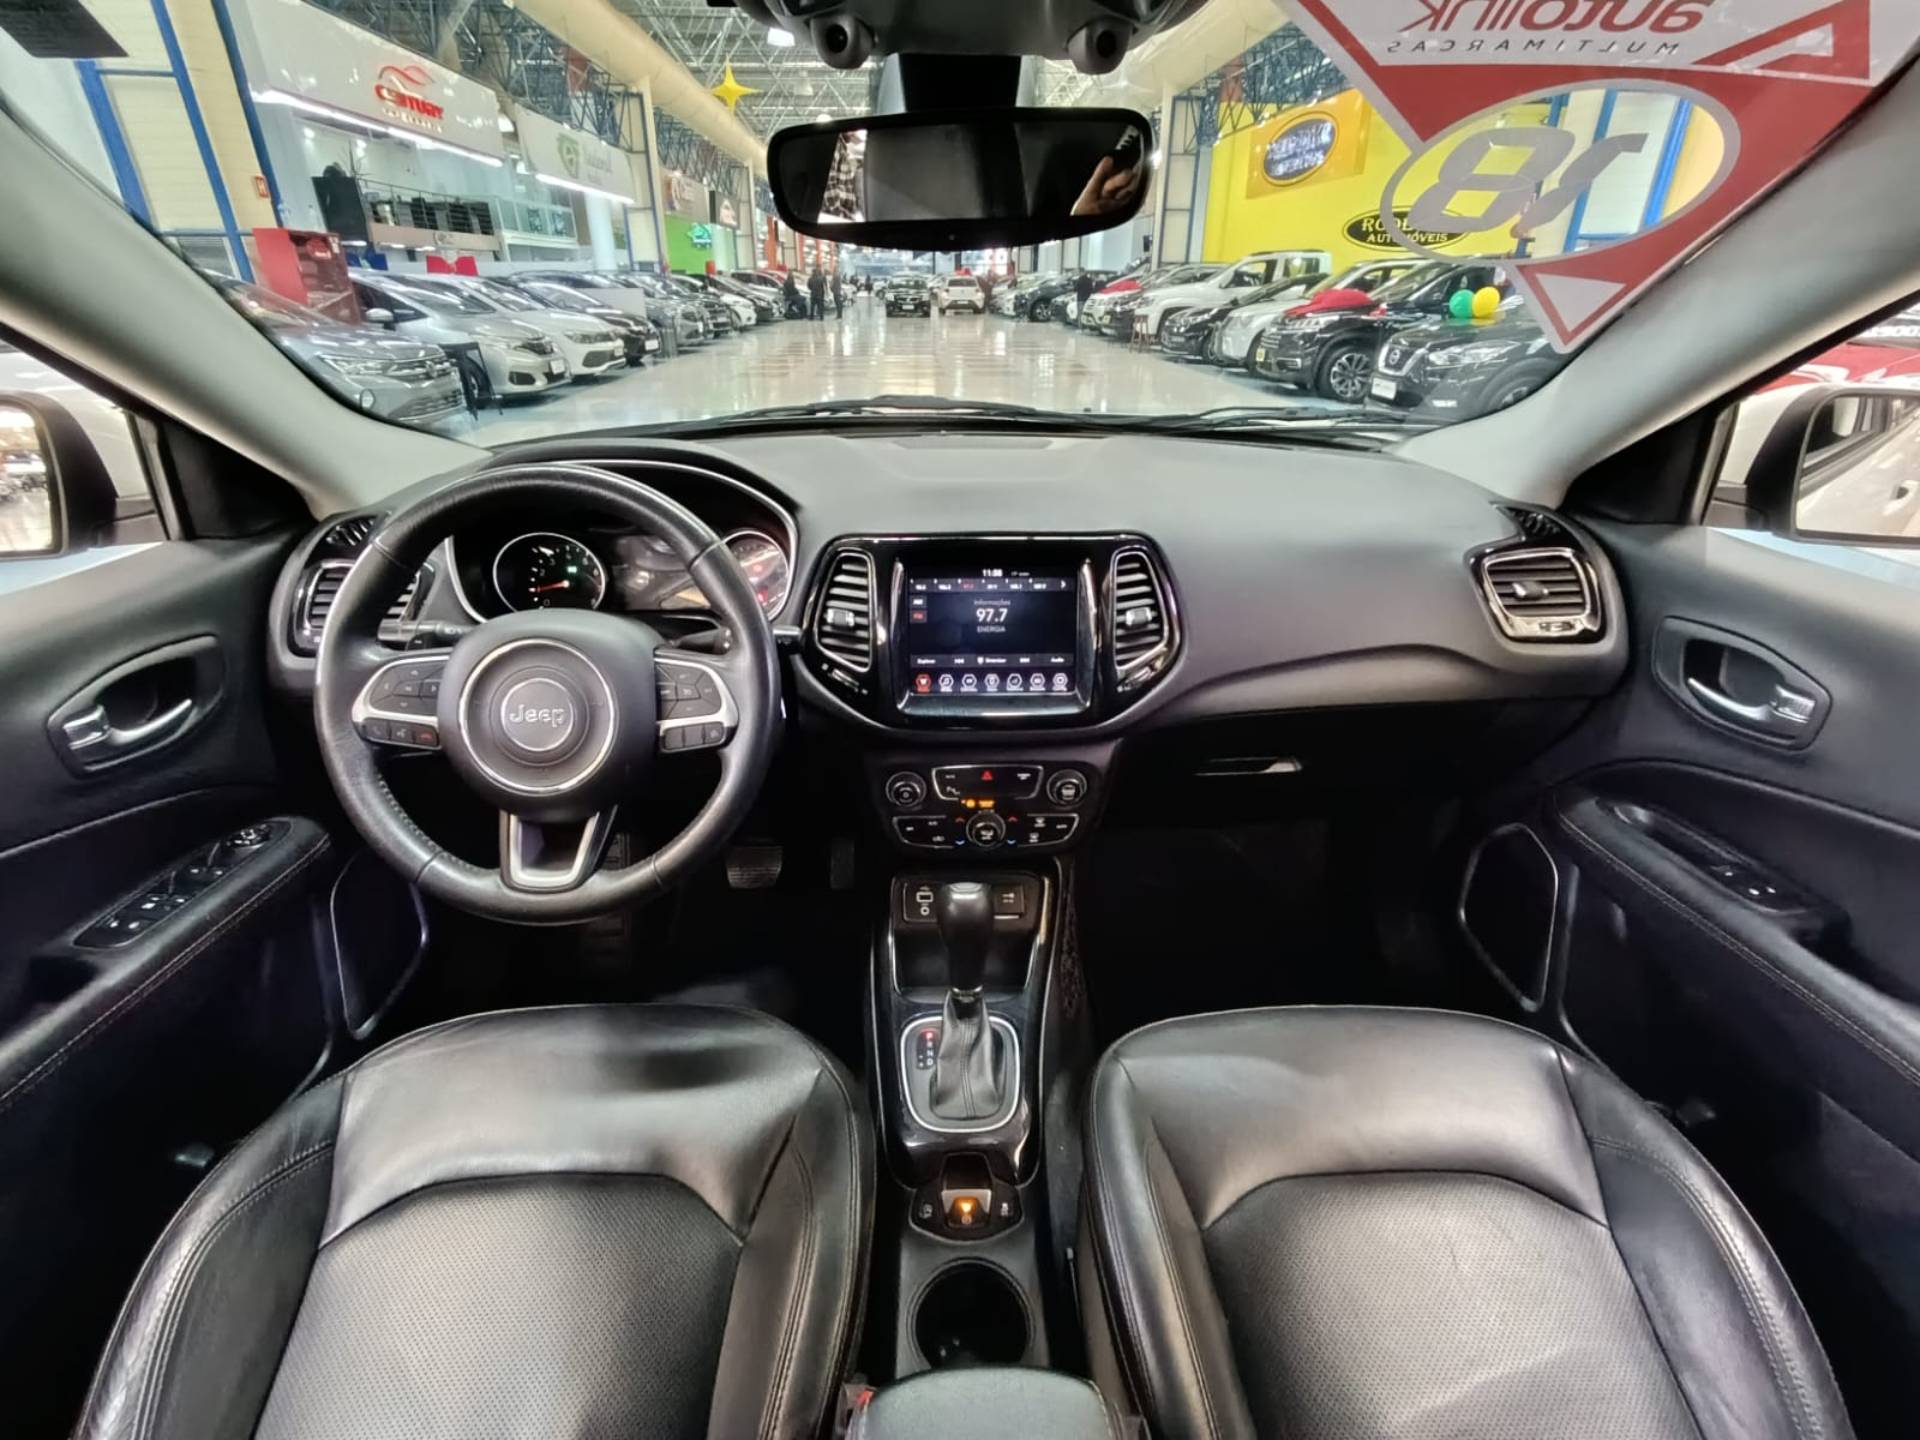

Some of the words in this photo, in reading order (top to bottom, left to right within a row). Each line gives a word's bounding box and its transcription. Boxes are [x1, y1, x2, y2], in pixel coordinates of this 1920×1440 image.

[1366, 231, 1448, 244] AUTÓVEIS
[976, 608, 1008, 622] 97.7
[509, 704, 565, 728] Jeep
